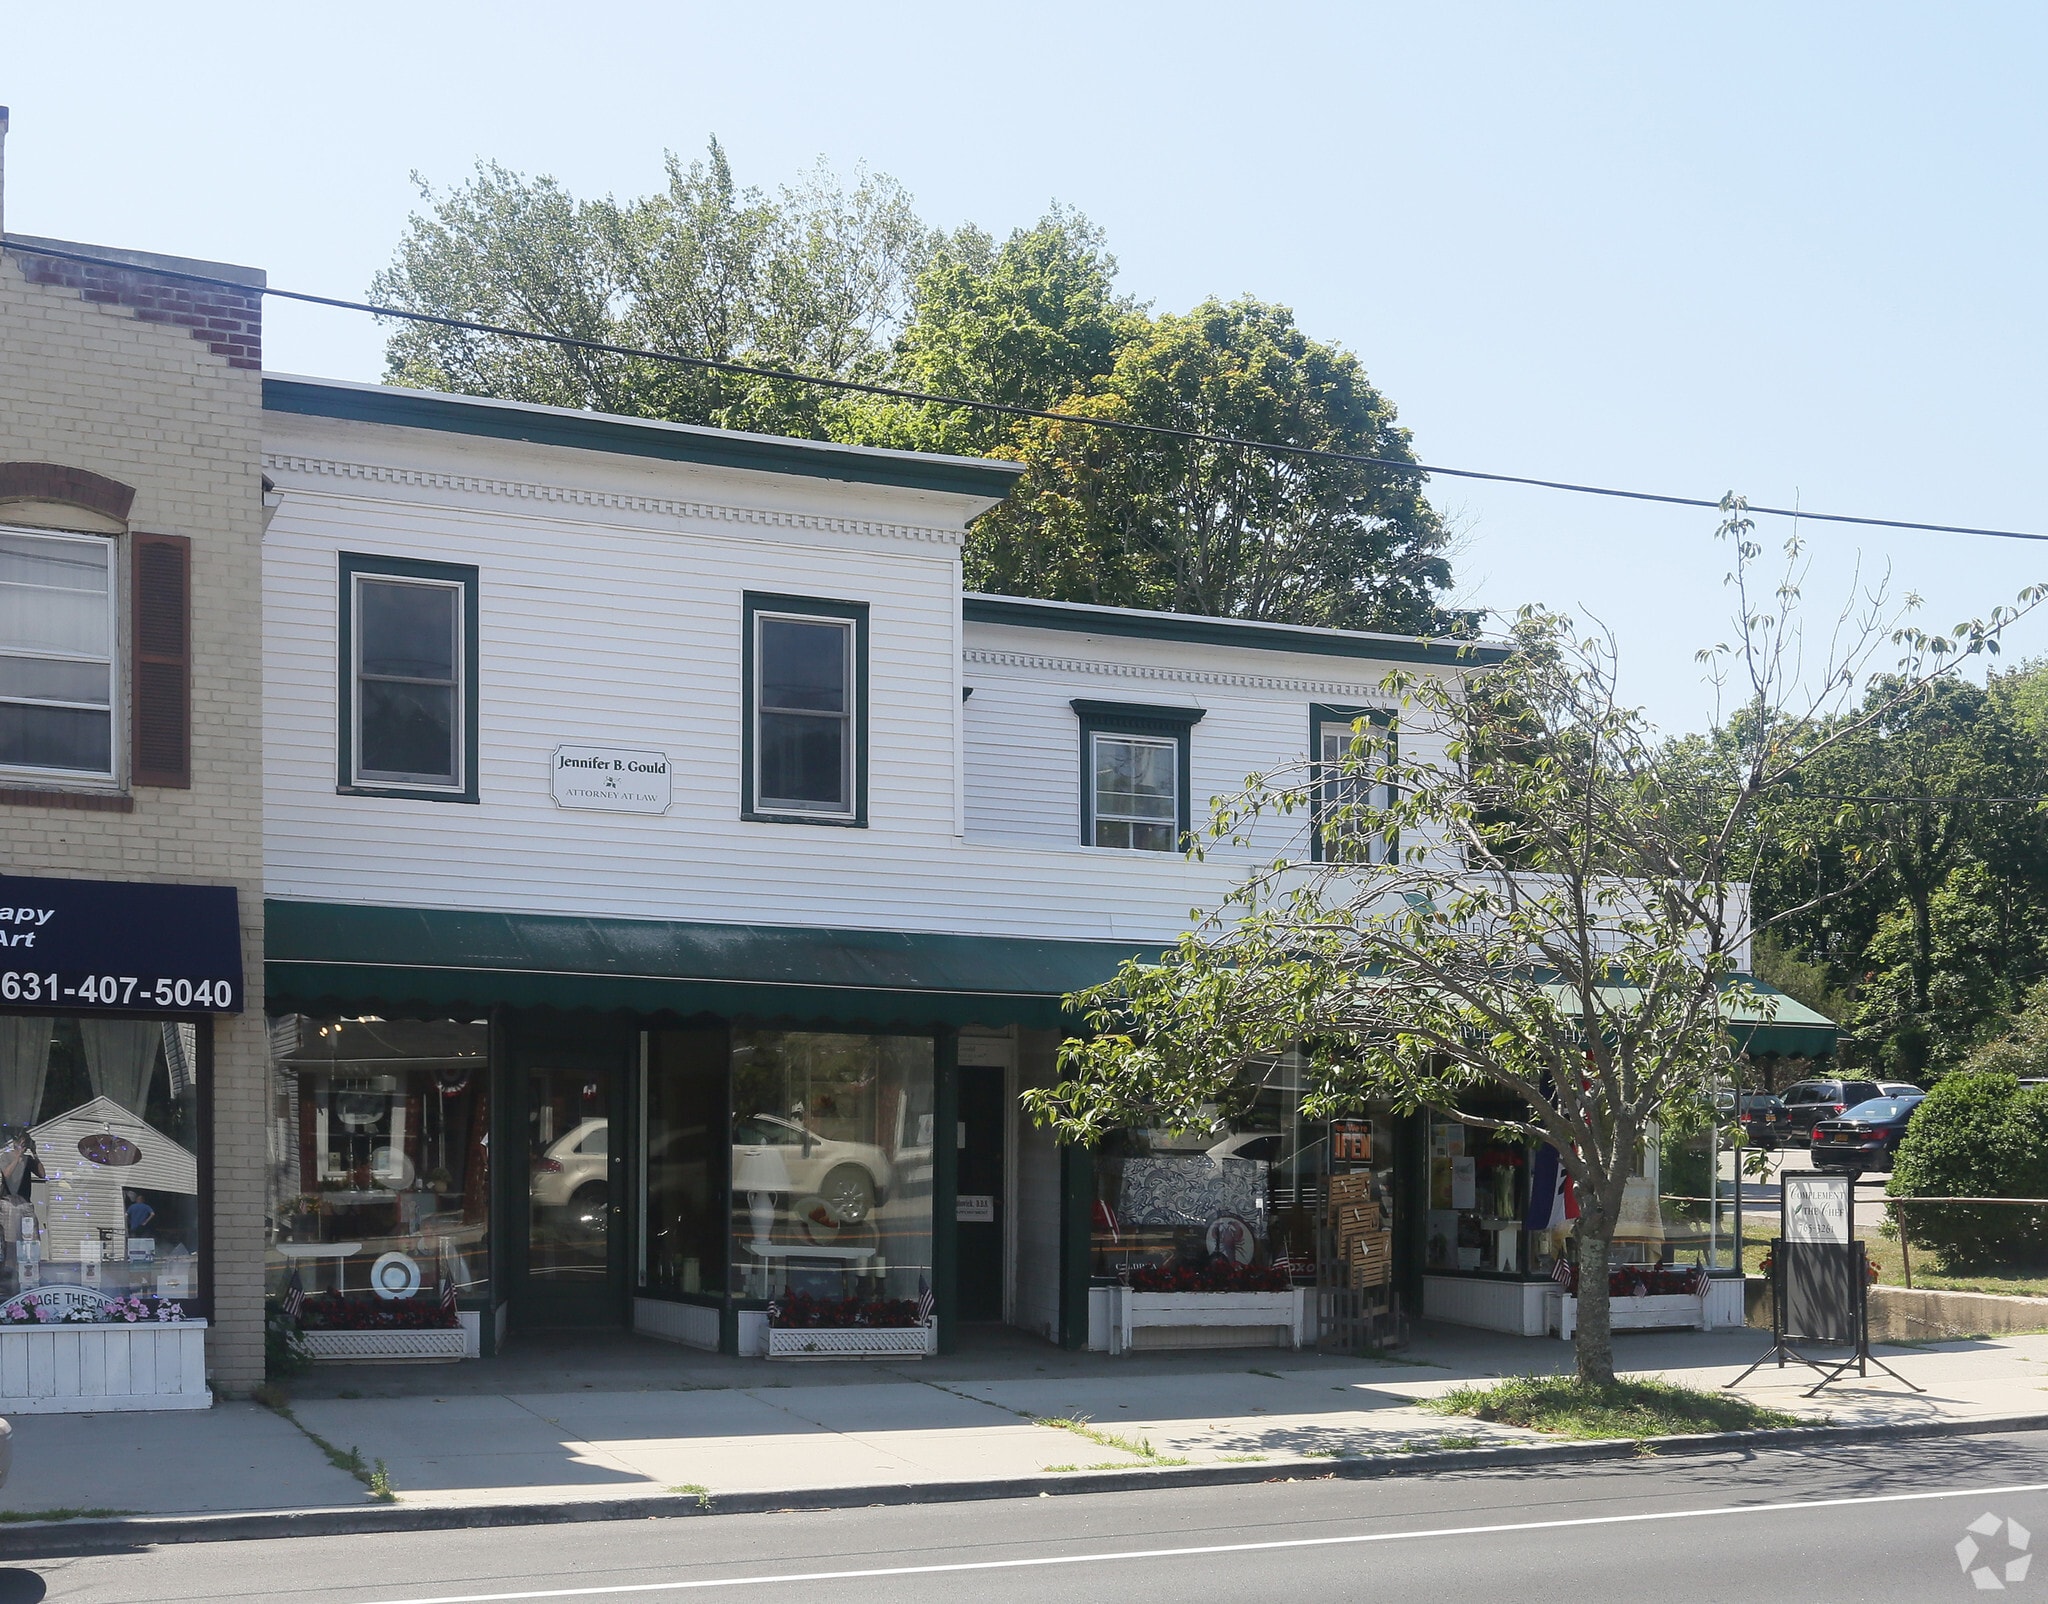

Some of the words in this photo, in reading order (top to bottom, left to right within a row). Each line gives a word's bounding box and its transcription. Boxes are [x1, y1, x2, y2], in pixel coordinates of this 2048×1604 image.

[558, 755, 610, 770] Jennifer
[613, 760, 625, 771] B.
[628, 760, 666, 774] Gould
[566, 789, 619, 799] ATTORNEY
[621, 792, 634, 800] AT
[636, 793, 658, 802] LAW
[1, 971, 232, 1008] 631-407-5040
[1790, 1184, 1845, 1200] COMPLEMENT
[1803, 1207, 1818, 1216] THE
[1821, 1202, 1845, 1217] CHEF
